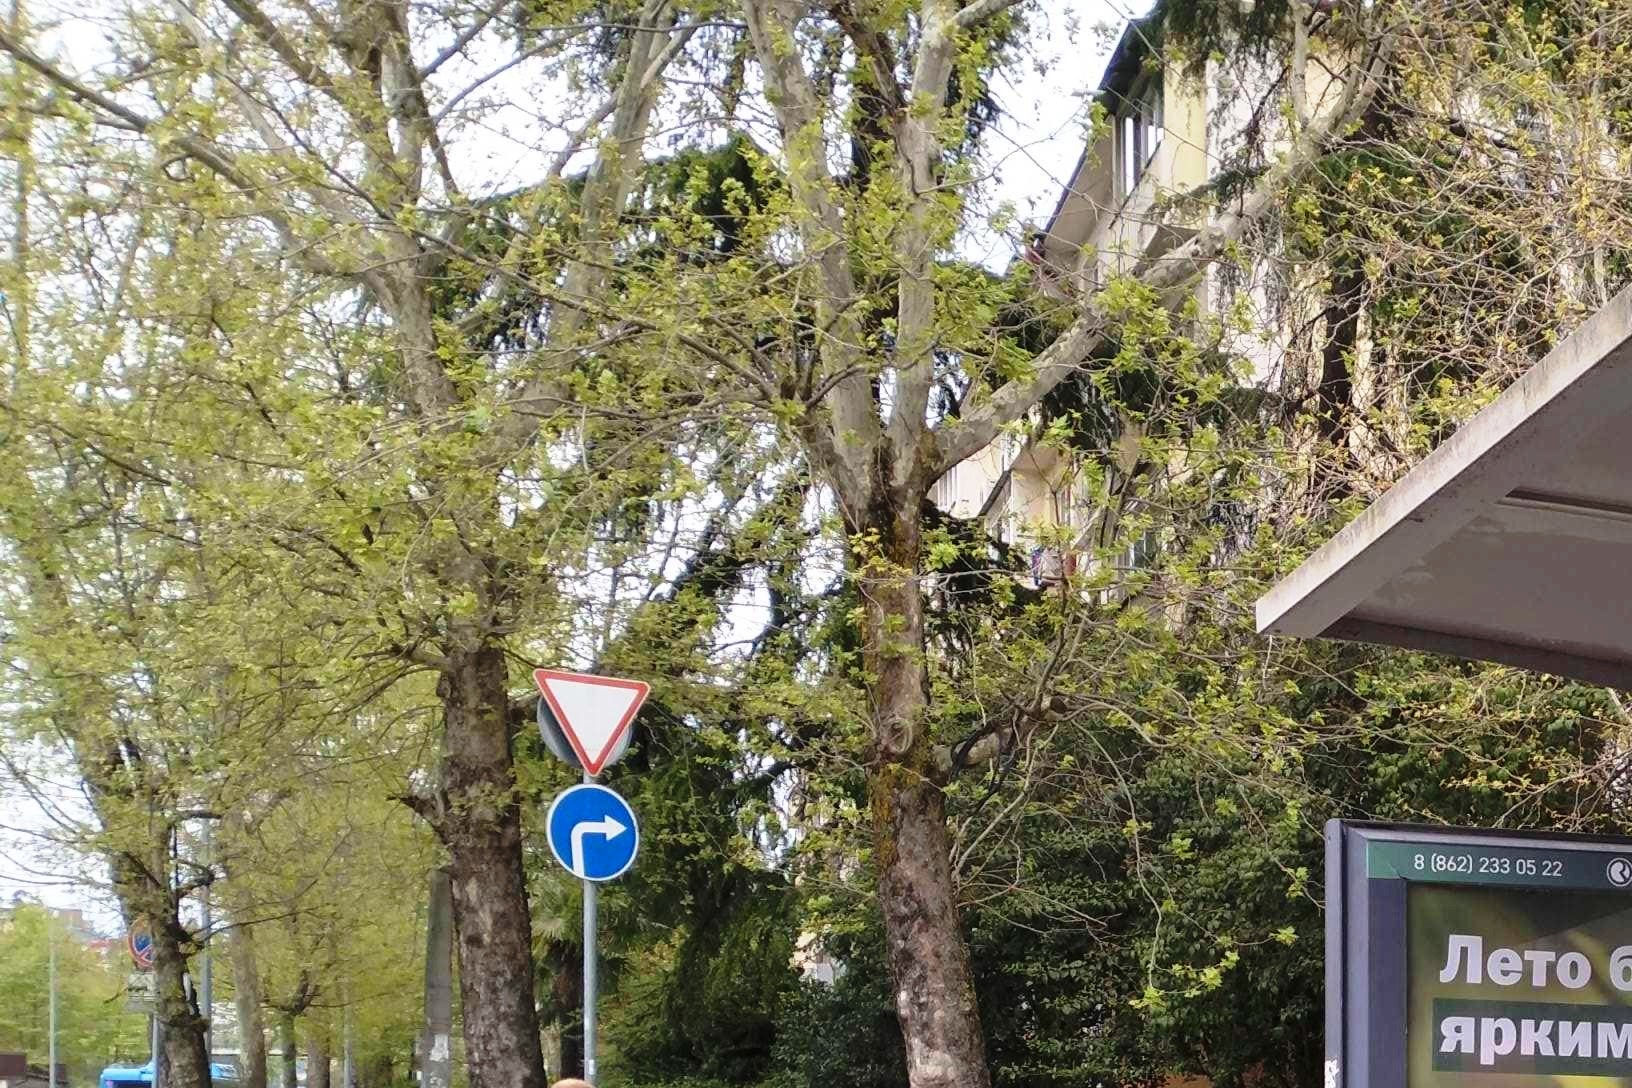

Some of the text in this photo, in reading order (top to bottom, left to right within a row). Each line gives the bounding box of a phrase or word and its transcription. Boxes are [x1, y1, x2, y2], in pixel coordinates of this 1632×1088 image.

[1413, 853, 1563, 877] 8 (862) 233 05 22
[1439, 934, 1593, 989] Лето
